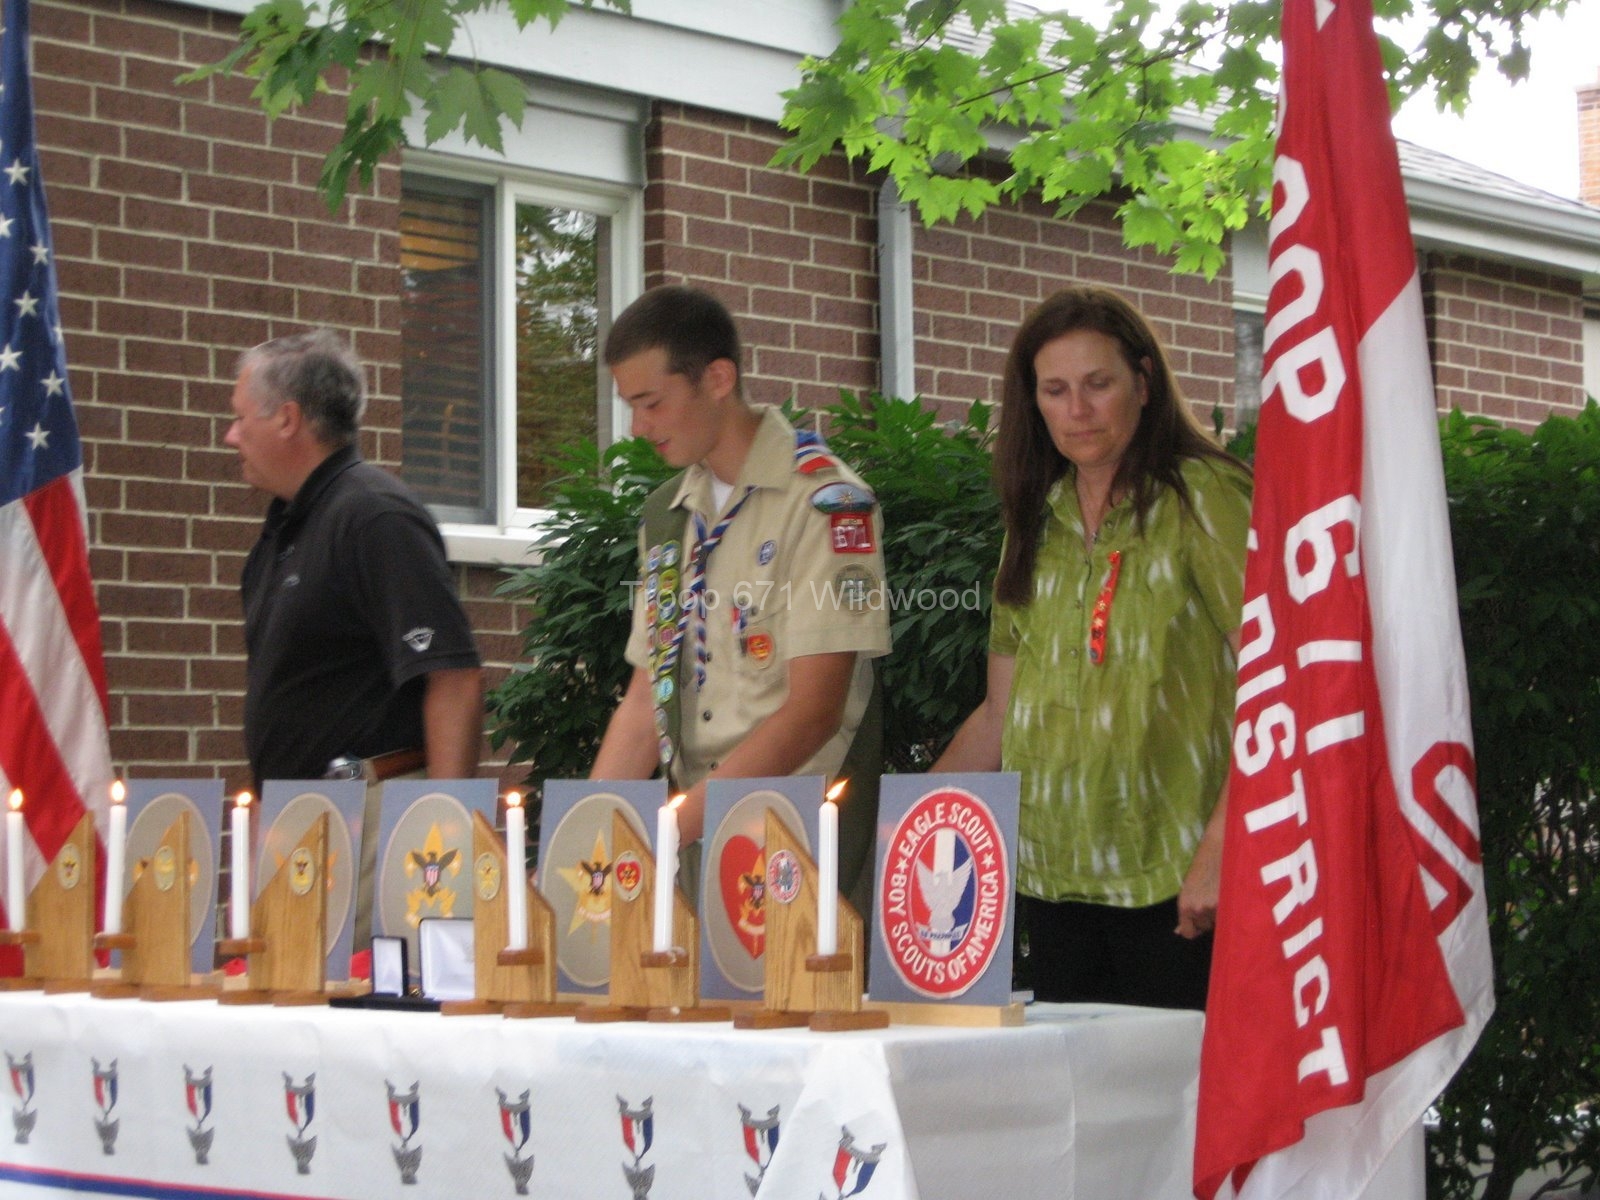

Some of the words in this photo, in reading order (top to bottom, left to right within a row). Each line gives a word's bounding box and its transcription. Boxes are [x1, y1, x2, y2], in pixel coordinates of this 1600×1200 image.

[898, 802, 946, 859] EAGLE
[949, 802, 994, 854] SCOUT
[1234, 592, 1349, 1086] DISTRICT
[888, 874, 908, 915] BOY
[967, 870, 999, 965] AMERICA
[892, 921, 946, 985] SCOUTS
[947, 957, 968, 982] OF
